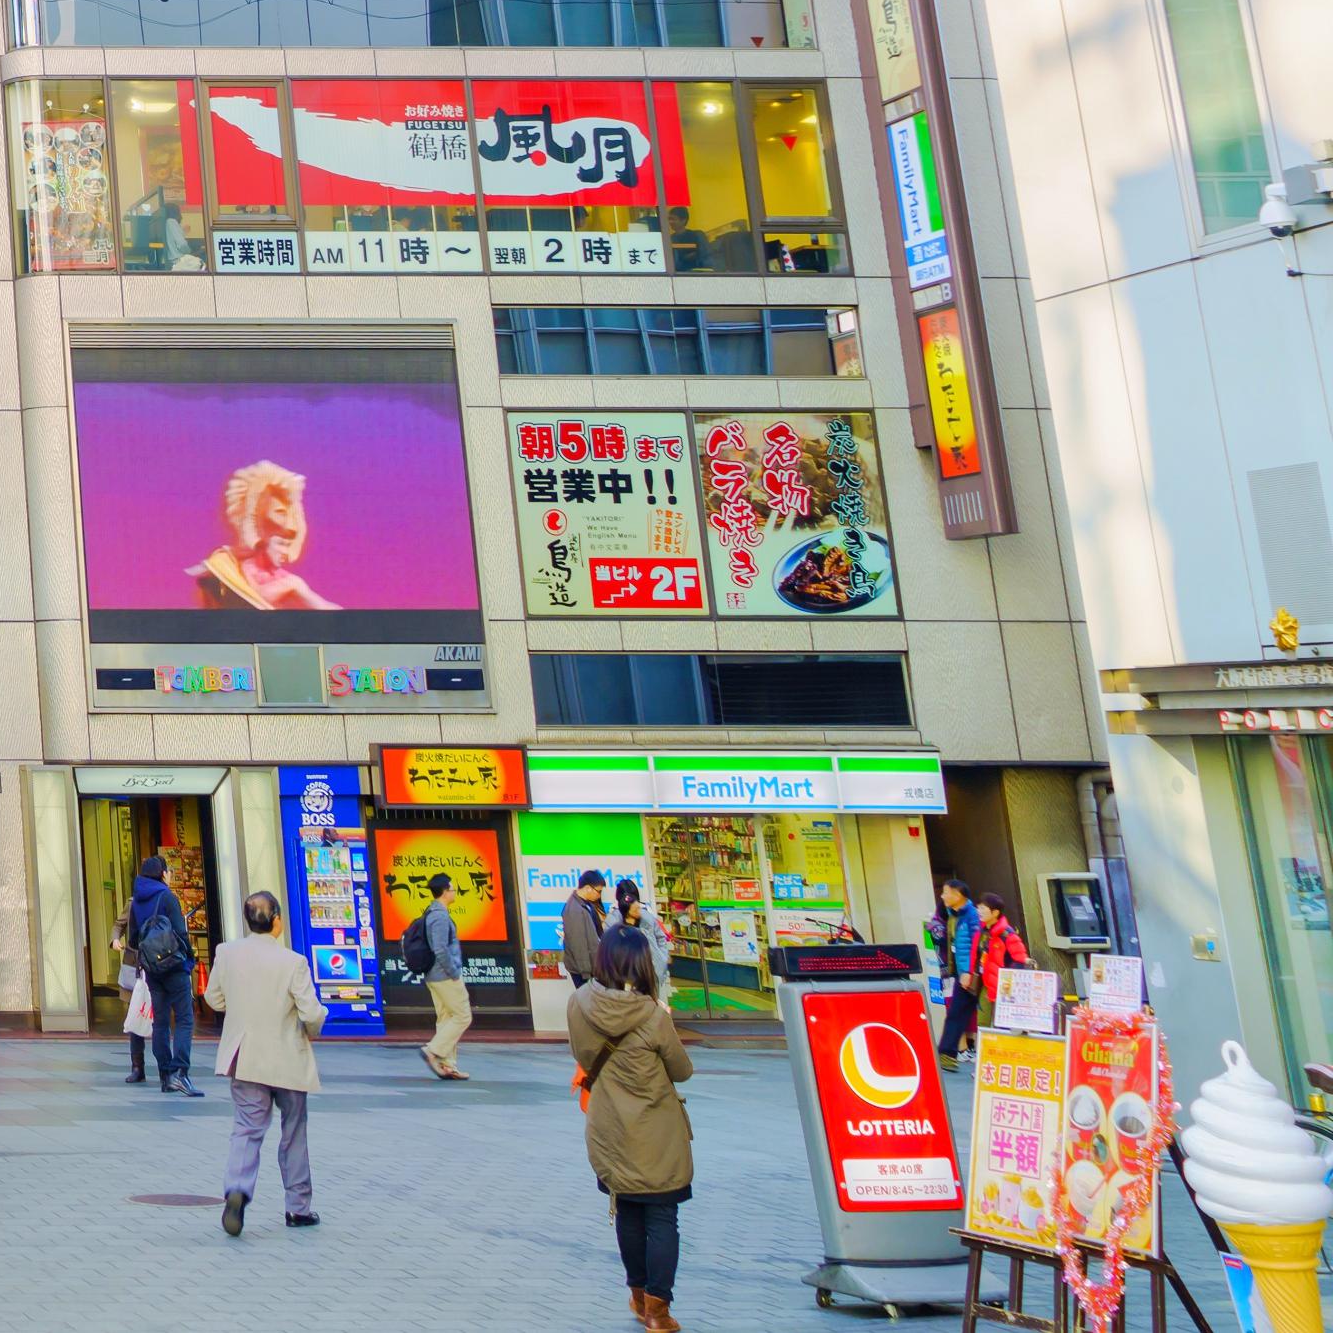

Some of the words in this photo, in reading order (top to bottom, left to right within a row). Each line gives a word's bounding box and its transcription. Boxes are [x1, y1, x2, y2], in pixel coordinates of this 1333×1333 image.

[404, 105, 464, 118] お好み焼き
[406, 120, 464, 131] FUGETSU
[407, 133, 467, 162] 鶴橋
[478, 104, 639, 189] 風月
[895, 128, 921, 236] FamilyMart
[218, 238, 295, 267] 営業時間
[311, 247, 344, 265] AM
[494, 244, 527, 268] 翌朝
[628, 248, 659, 267] まで
[517, 419, 684, 465] 朝5時まで
[595, 564, 643, 581] 当ビル
[649, 565, 698, 601] 2F
[156, 666, 254, 694] TOMBORI
[328, 663, 425, 697] STATION
[414, 752, 490, 764] 炭火焼だいにんぐ
[437, 793, 476, 802] watamin-chi
[681, 774, 815, 804] FamilyMart
[902, 786, 935, 801] 戎橋店
[301, 812, 336, 826] BOSS
[302, 834, 322, 843] BOSS
[392, 855, 484, 868] 炭火焼だいにんぐ
[384, 871, 498, 903] わたん家
[774, 874, 803, 886] たばこ
[1081, 1041, 1135, 1068] Ghana
[993, 1100, 1030, 1127] ポテト
[846, 1119, 935, 1137] LOTTERIA
[990, 1129, 1040, 1174] 半額
[877, 1162, 924, 1177] 客席40席
